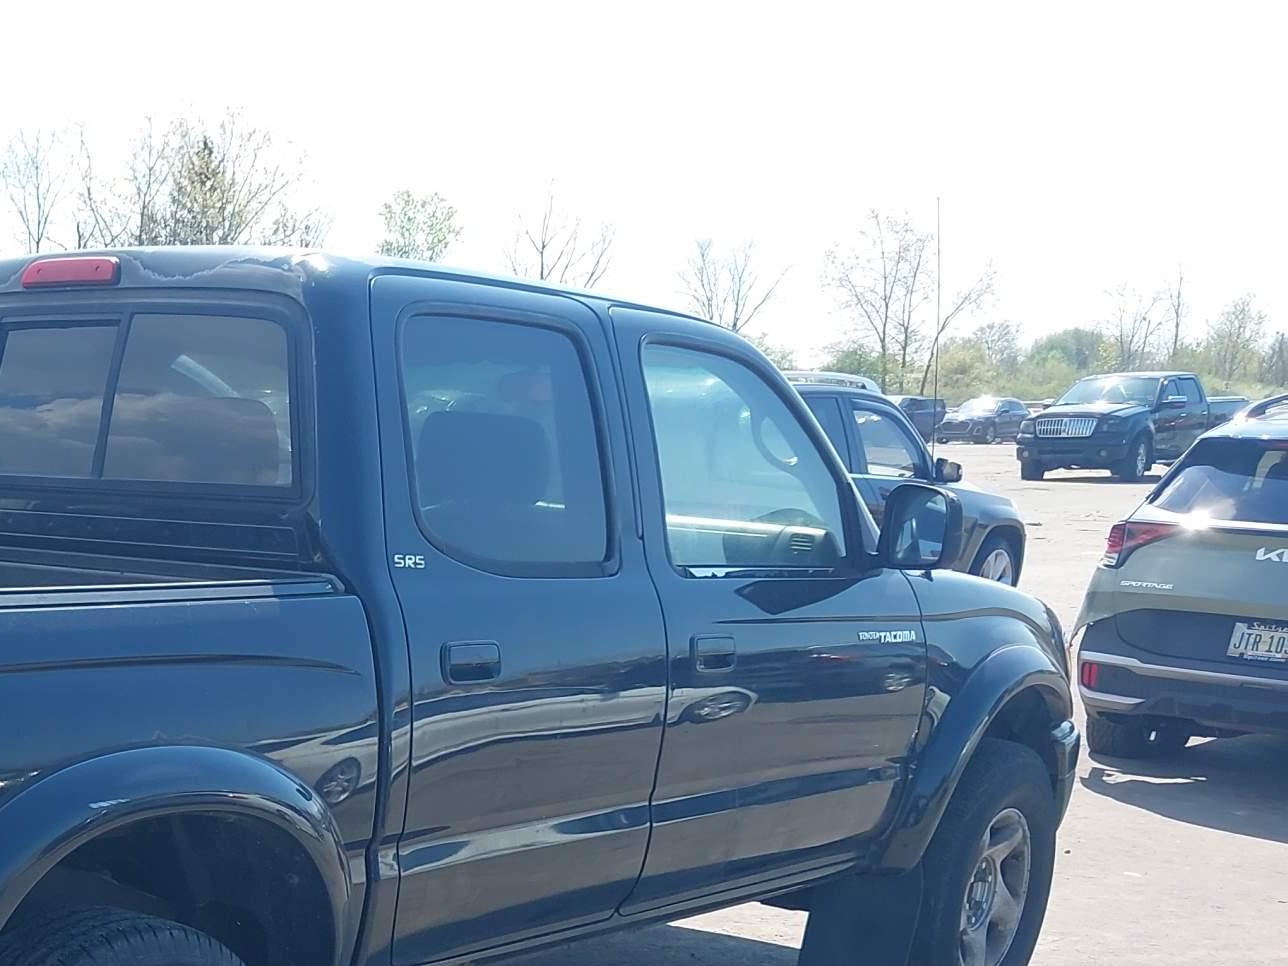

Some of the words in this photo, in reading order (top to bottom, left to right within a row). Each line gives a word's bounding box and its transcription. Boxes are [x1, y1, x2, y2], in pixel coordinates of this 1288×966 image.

[394, 554, 425, 569] SR5
[1119, 580, 1174, 590] SPORTAGE
[879, 630, 916, 644] TACOMA
[1233, 632, 1262, 652] JTR
